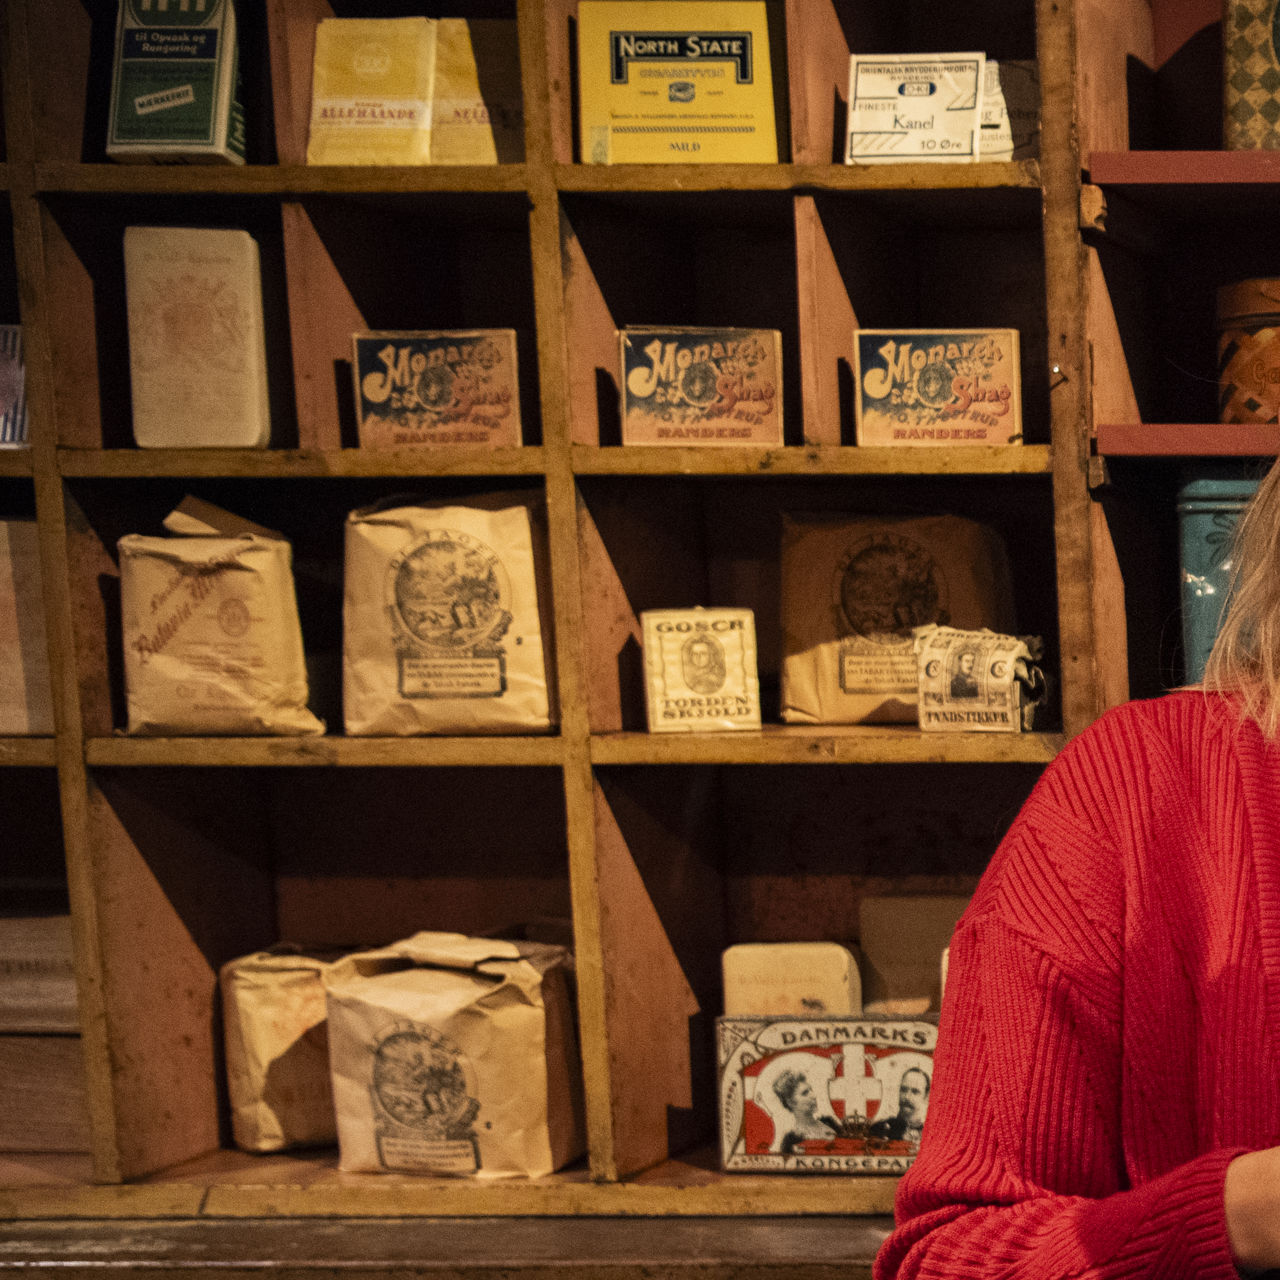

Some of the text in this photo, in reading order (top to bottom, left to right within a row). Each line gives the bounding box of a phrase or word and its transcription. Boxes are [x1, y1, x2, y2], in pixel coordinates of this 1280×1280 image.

[620, 34, 743, 58] NORTH STATE
[894, 114, 934, 130] Kanel
[921, 139, 962, 150] 10 Øre
[627, 338, 768, 398] Monarch
[863, 339, 1004, 400] Monarch
[938, 375, 1012, 417] Shag
[657, 427, 752, 439] RANDERS
[893, 427, 987, 440] RANDERS
[656, 620, 744, 633] GOSCH
[663, 696, 748, 708] TORDEN
[663, 707, 751, 719] SKJOLD
[781, 1025, 928, 1047] DANMARKS
